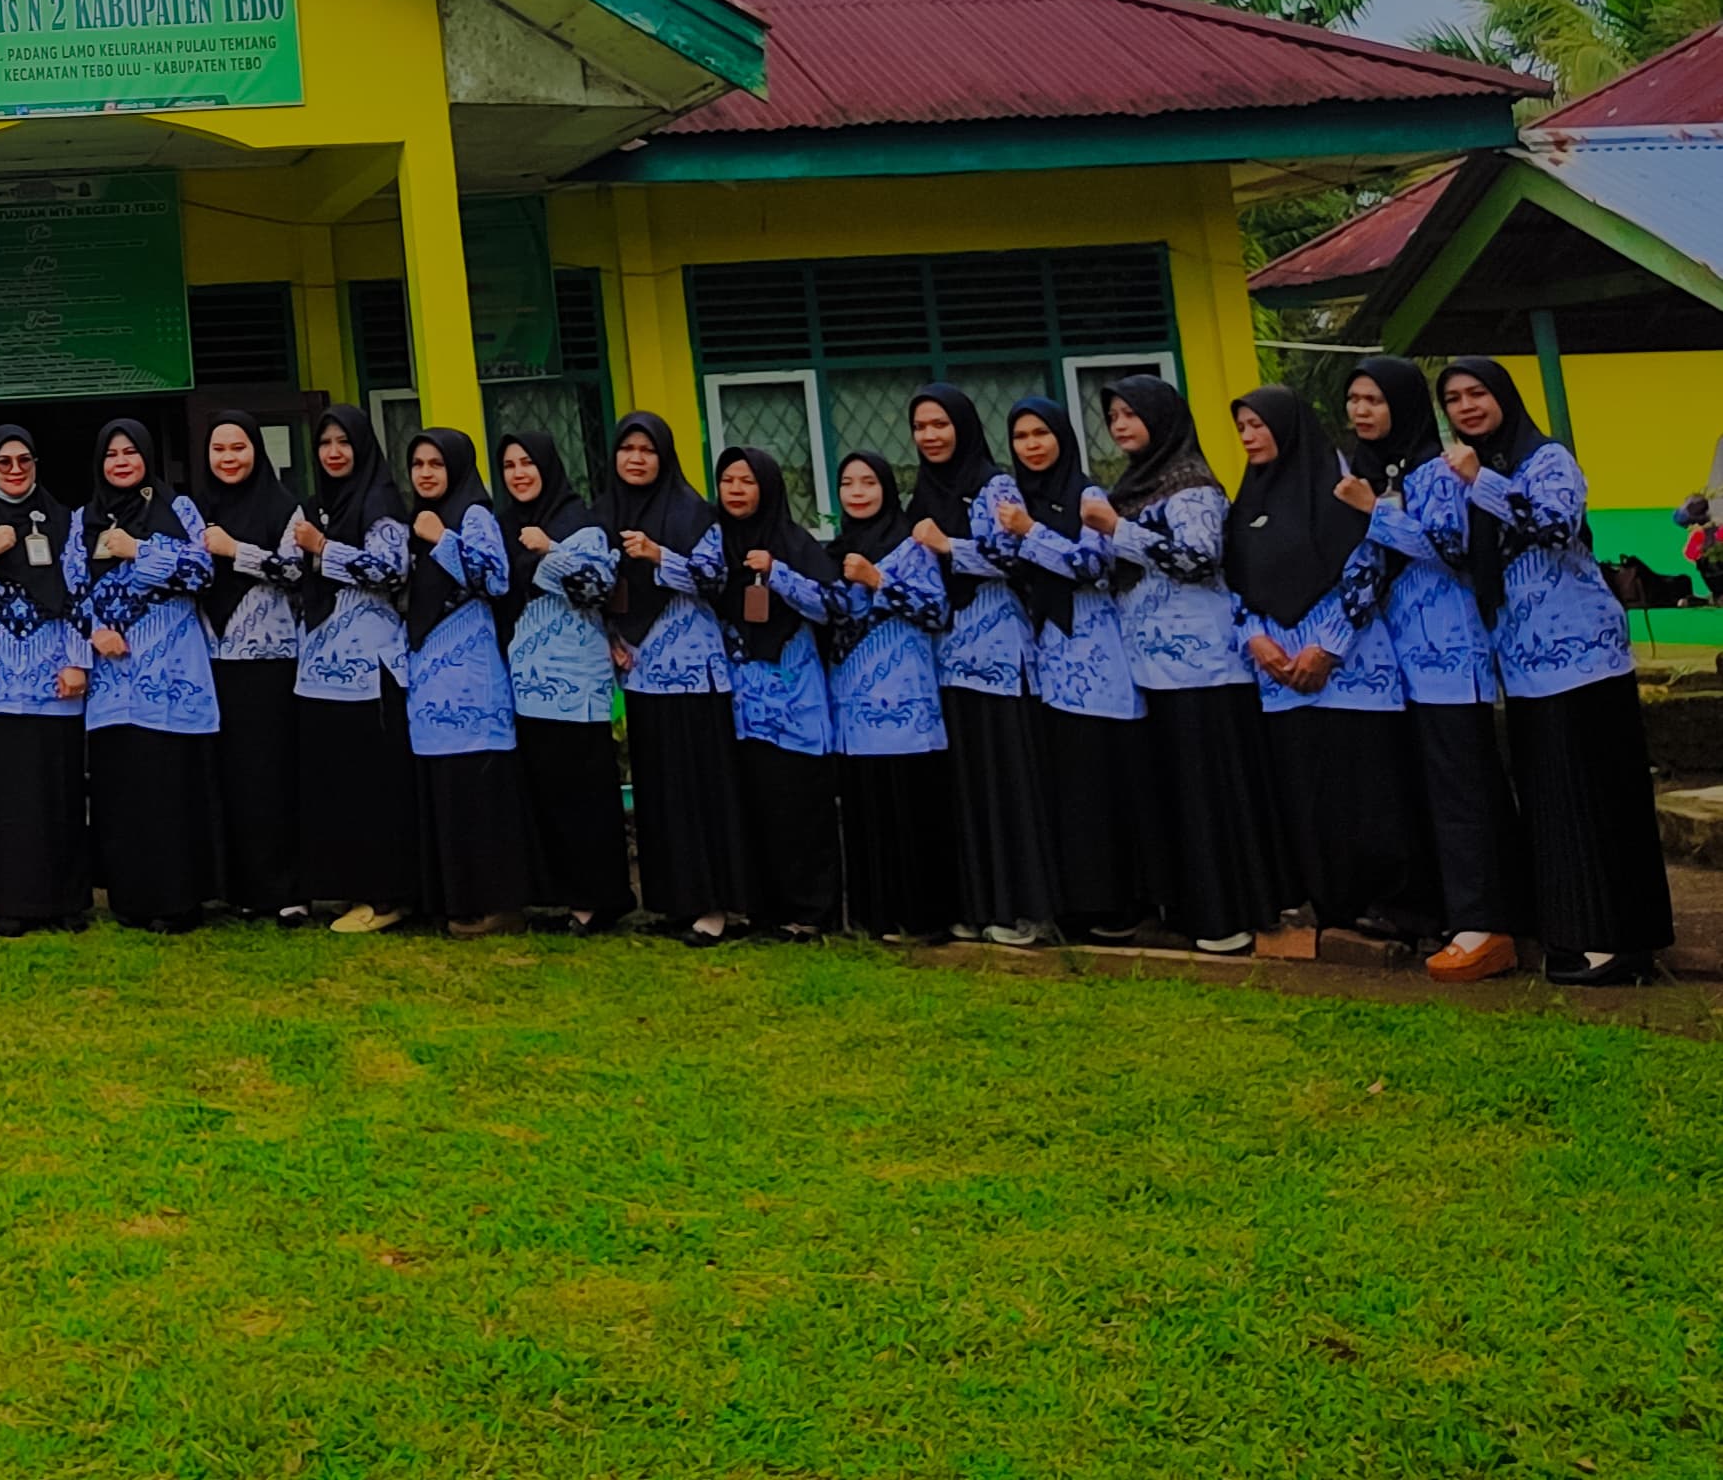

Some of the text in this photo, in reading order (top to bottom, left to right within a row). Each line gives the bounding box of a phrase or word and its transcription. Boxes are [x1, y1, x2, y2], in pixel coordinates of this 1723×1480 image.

[7, 46, 58, 61] PADANG
[62, 44, 95, 59] LAMO
[100, 40, 173, 57] KELURAHAN
[177, 38, 216, 53] PULAU
[220, 35, 277, 51] TEMIANG
[4, 65, 77, 82] KECAMATAN
[82, 63, 113, 78] TEBO
[117, 61, 141, 77] ULU
[154, 59, 226, 75] KABUPATEN
[230, 56, 262, 71] TEBO
